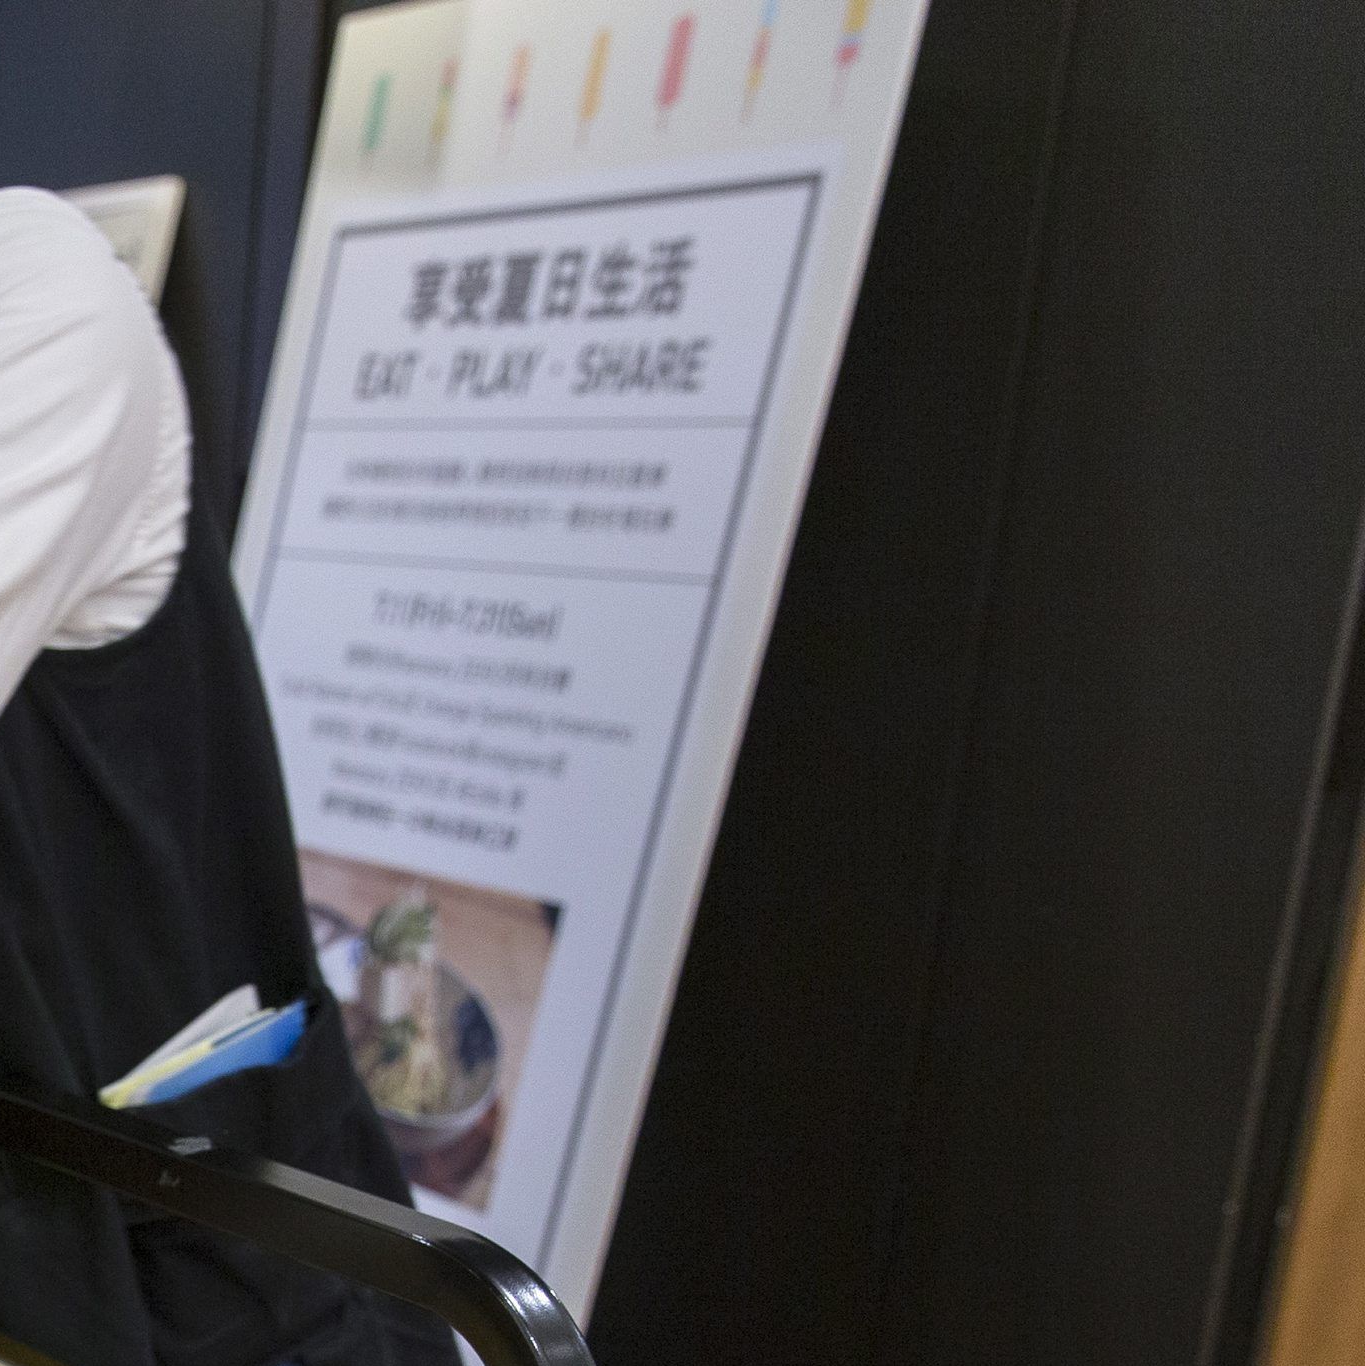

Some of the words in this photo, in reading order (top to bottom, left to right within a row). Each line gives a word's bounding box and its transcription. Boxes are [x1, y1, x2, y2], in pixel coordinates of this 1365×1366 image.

[404, 233, 695, 330] 享受夏日生活
[353, 350, 418, 399] EAT
[445, 348, 545, 399] PLAY
[572, 338, 710, 397] SHARE
